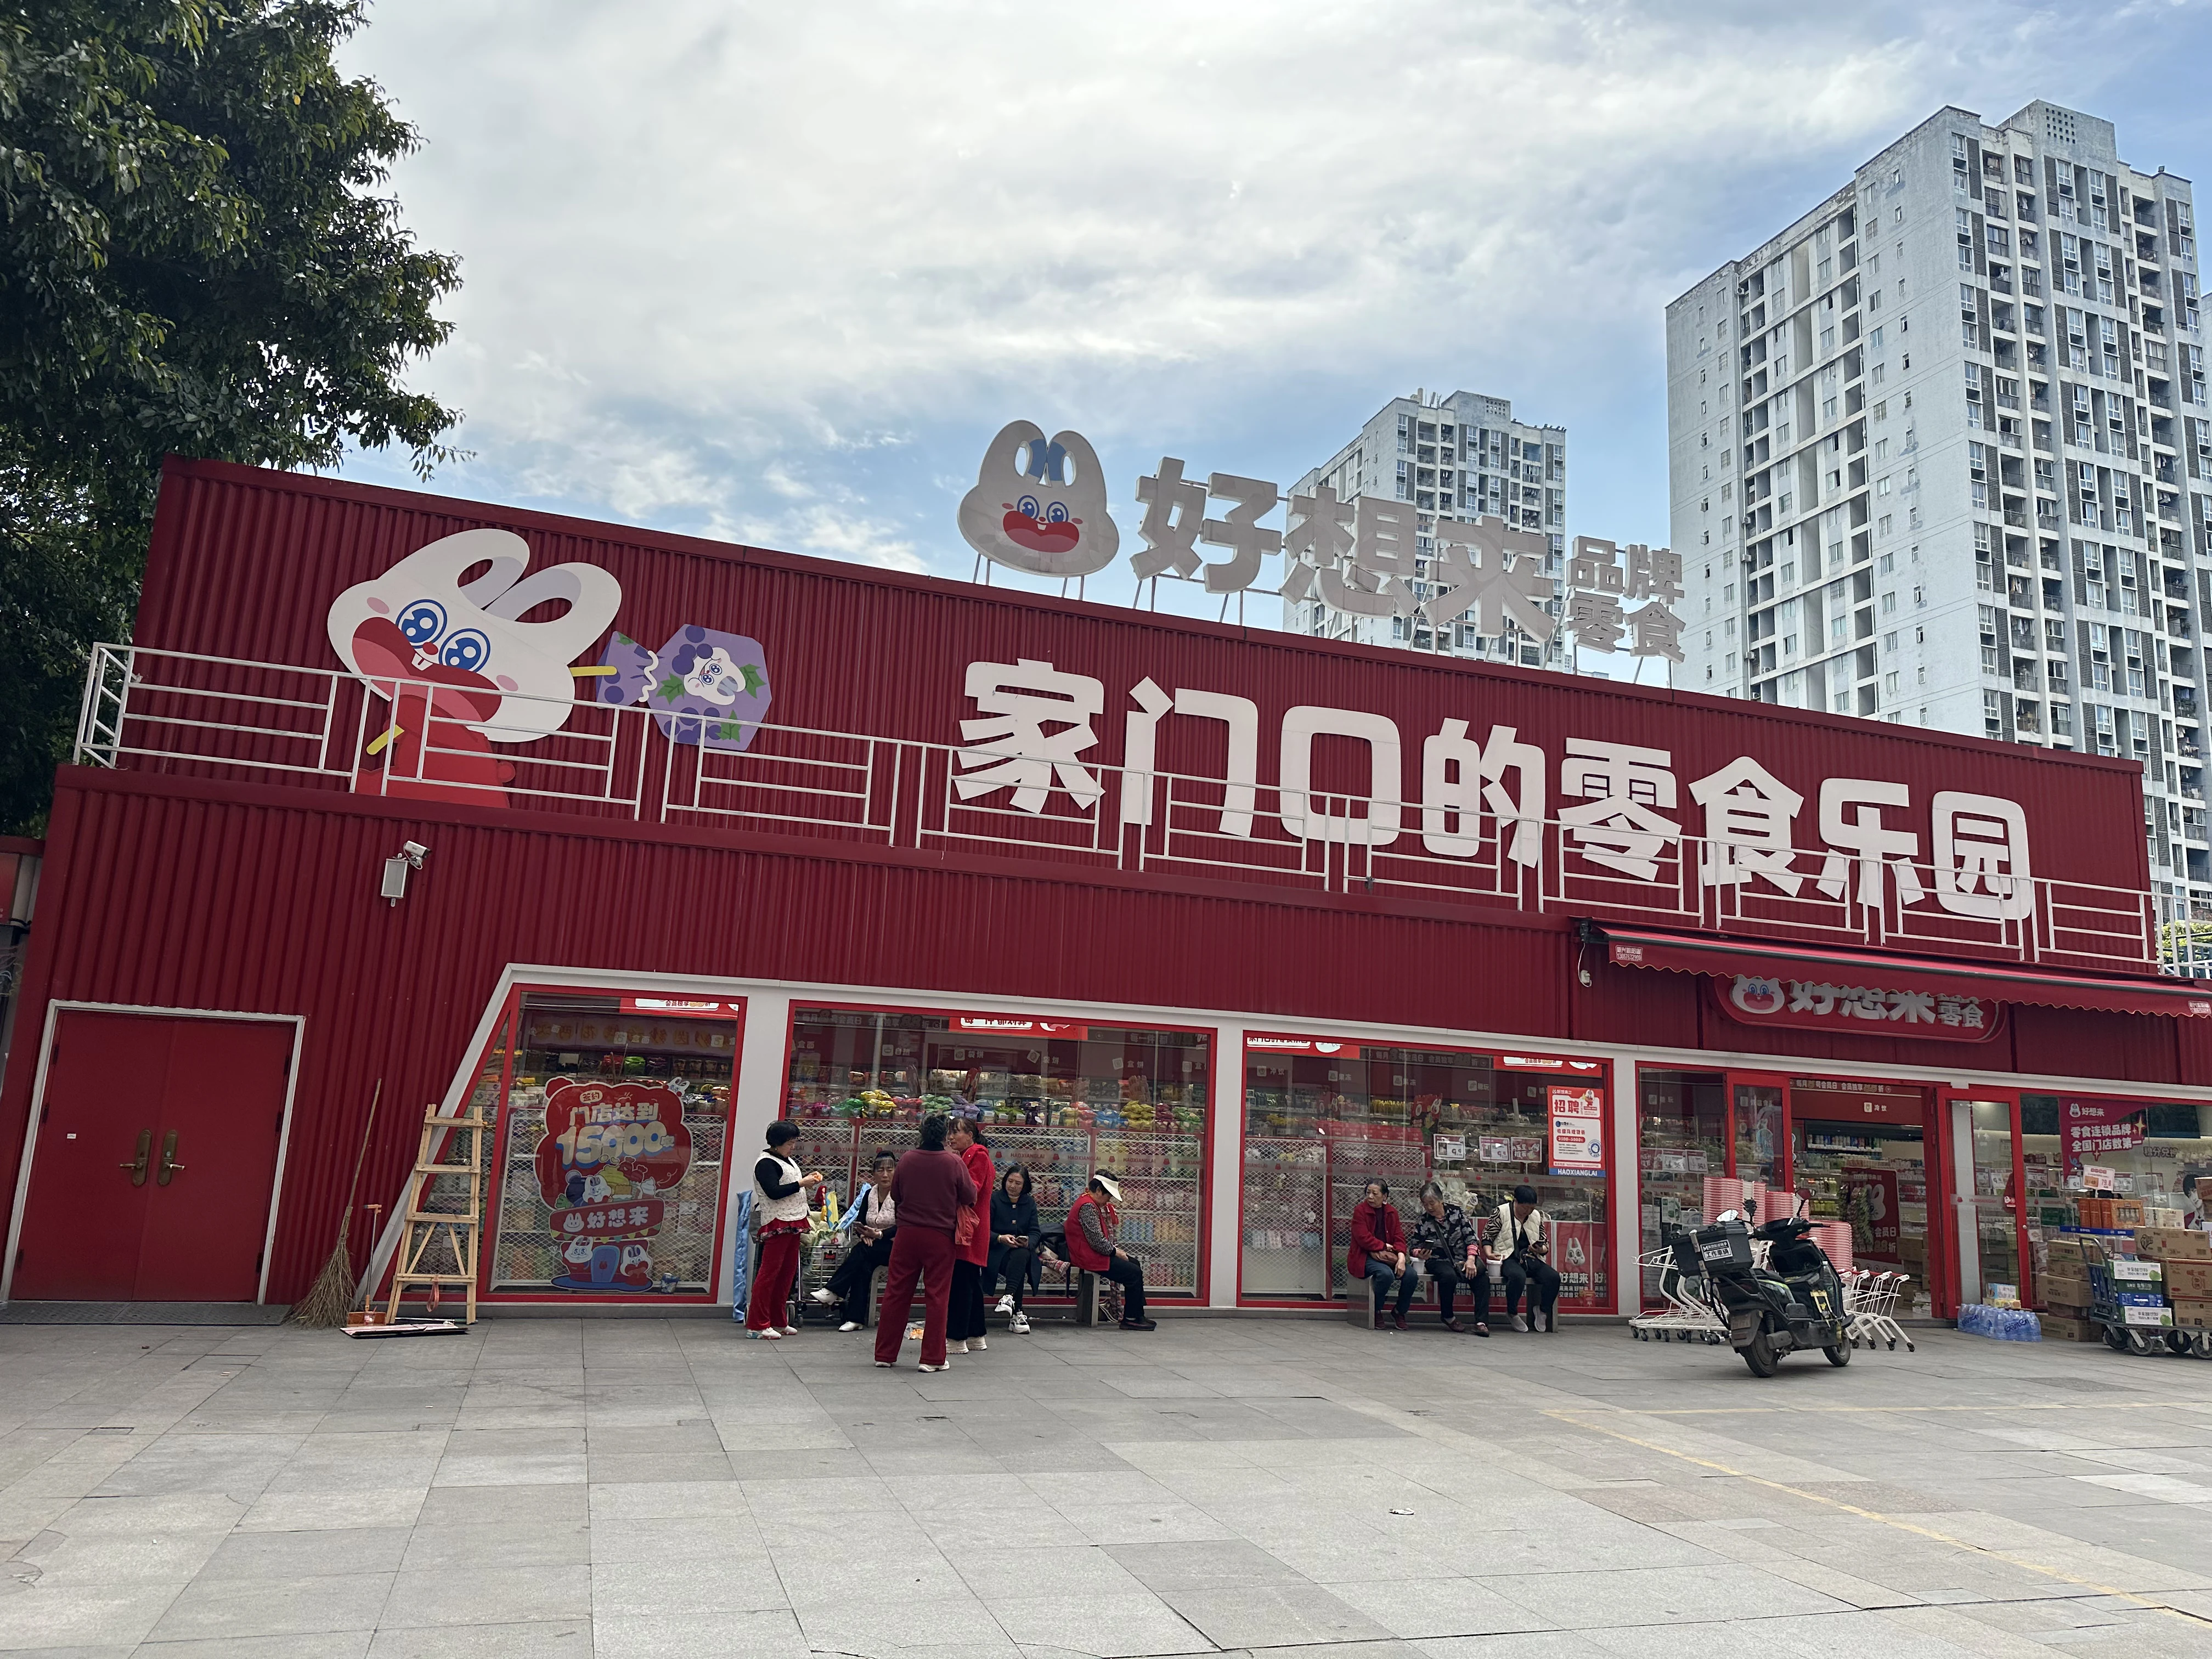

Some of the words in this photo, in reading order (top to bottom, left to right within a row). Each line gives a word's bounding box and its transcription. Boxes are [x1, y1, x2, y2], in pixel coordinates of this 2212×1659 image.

[1132, 456, 1556, 644] 好想来
[1566, 535, 1684, 605] 品牌
[1563, 591, 1686, 664] 零食
[953, 658, 2032, 921] 家门口的零食乐园
[1787, 980, 1936, 1024] 好想来
[1937, 1000, 1984, 1029] 零食
[569, 1102, 659, 1126] 门店达到
[1554, 1099, 1579, 1114] 招聘
[1874, 1104, 1887, 1112] 冷饮
[2081, 1107, 2104, 1116] 好想来
[2070, 1123, 2131, 1138] 零食连锁品牌
[2072, 1137, 2142, 1152] 全国门店数第一
[1558, 1168, 1598, 1176] HAOXIANGLAI
[587, 1206, 649, 1229] 好想来
[1875, 1227, 1897, 1238] 会员日
[1559, 1272, 1589, 1283] 好想来
[1594, 1272, 1606, 1283] 好
